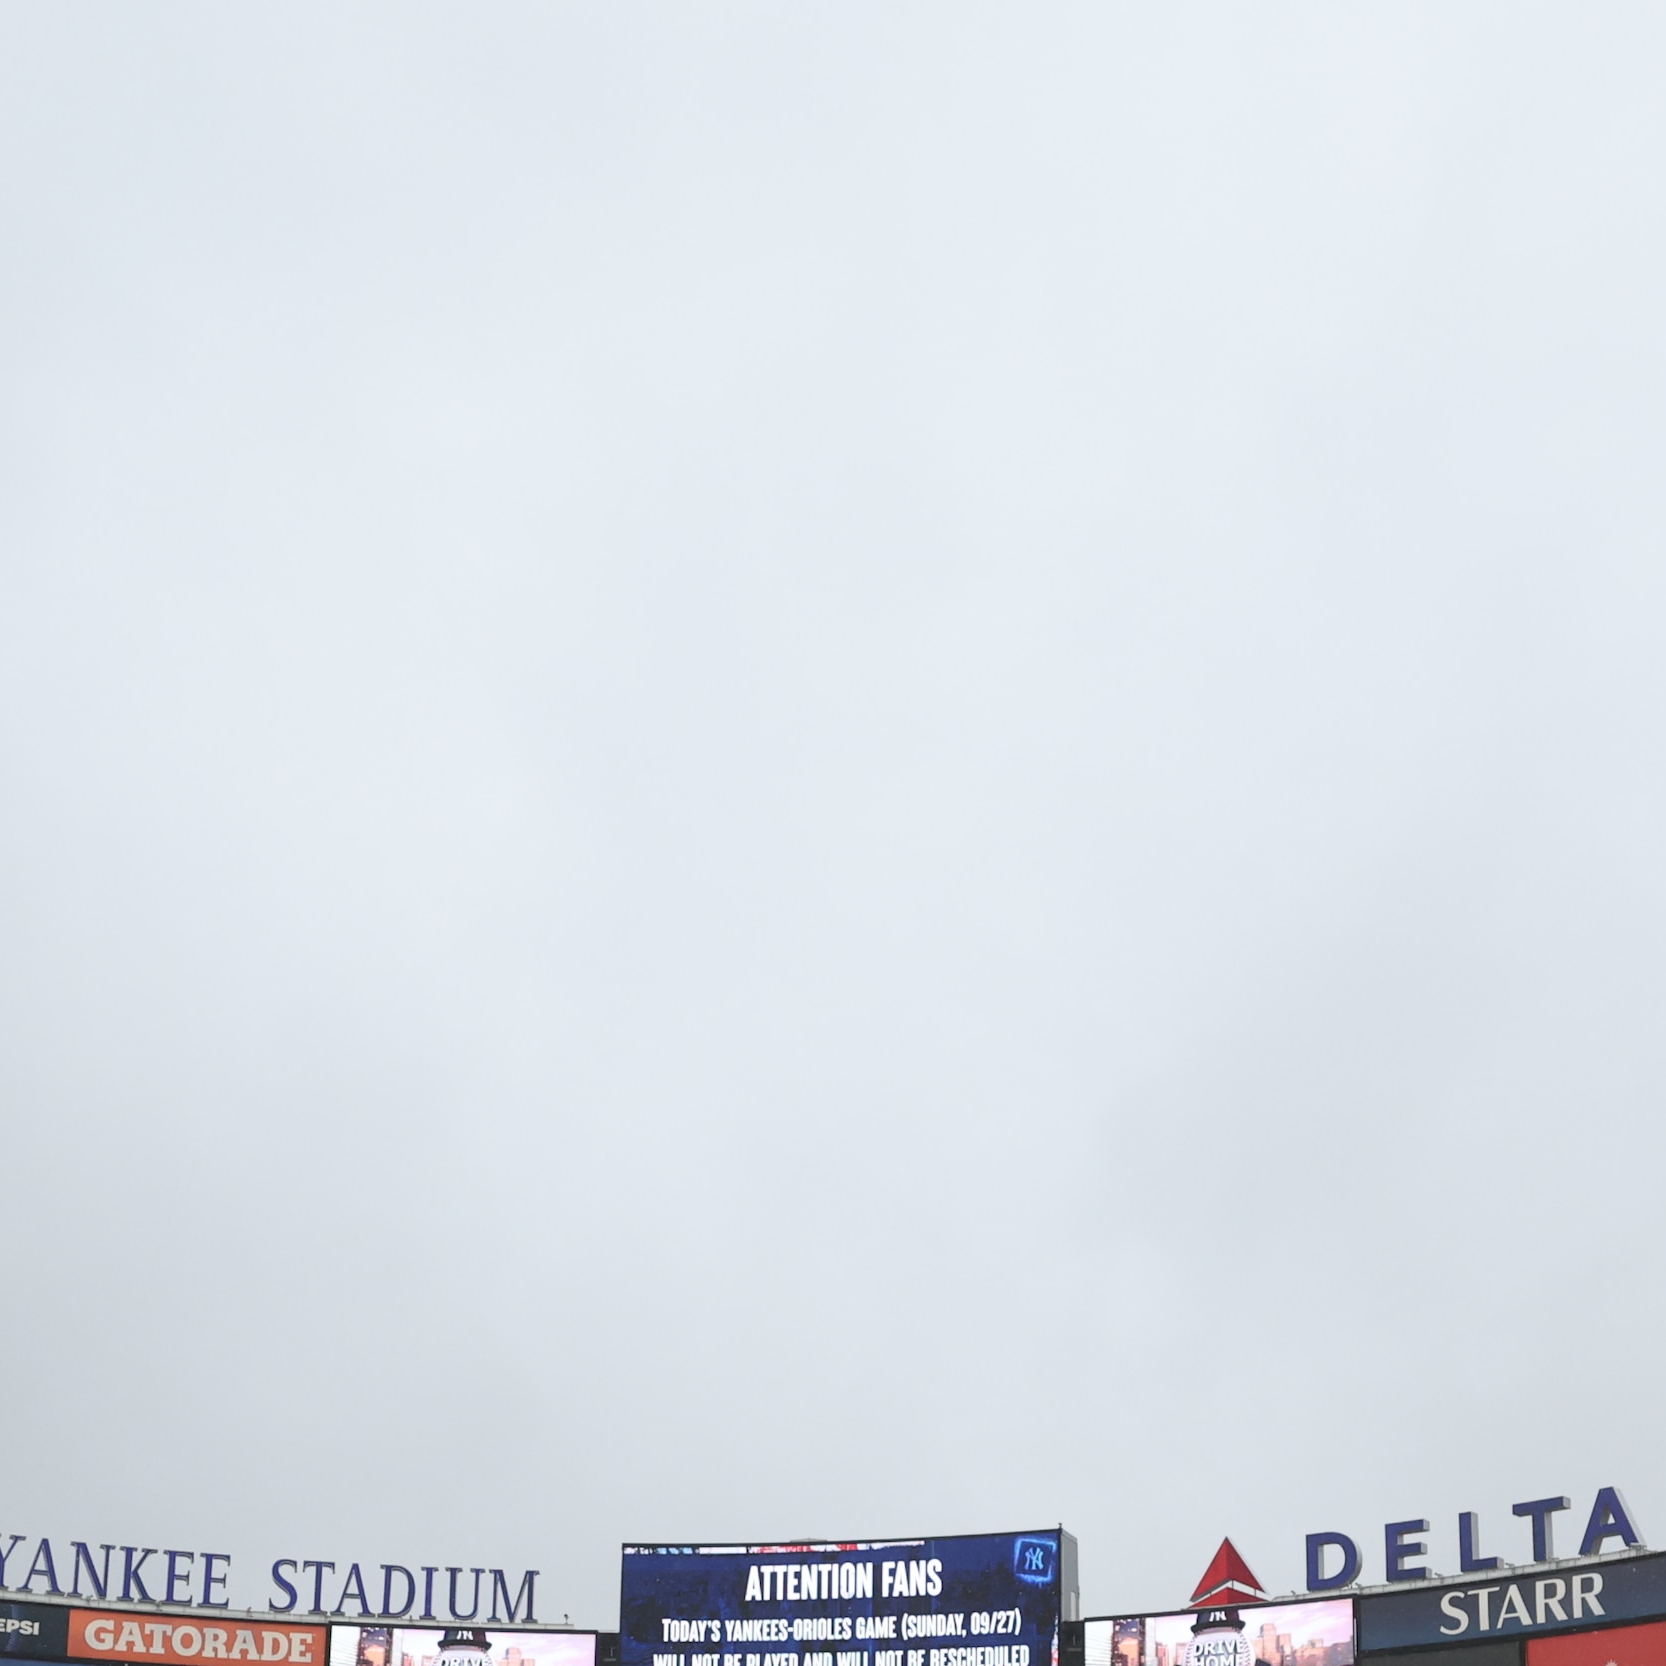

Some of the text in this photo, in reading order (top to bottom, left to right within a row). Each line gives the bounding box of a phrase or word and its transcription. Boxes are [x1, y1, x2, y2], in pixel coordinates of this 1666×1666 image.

[1305, 1486, 1646, 1592] DELTA
[268, 1557, 540, 1623] STADIUM
[745, 1559, 942, 1600] ATTENTION FANS
[662, 1607, 1021, 1642] TODAY'S YANKEES-ORIOLES GAME (SUNDAY, 09/27)
[1439, 1573, 1605, 1635] STARR
[84, 1620, 313, 1662] GATORADE
[1194, 1640, 1244, 1656] DRIVE
